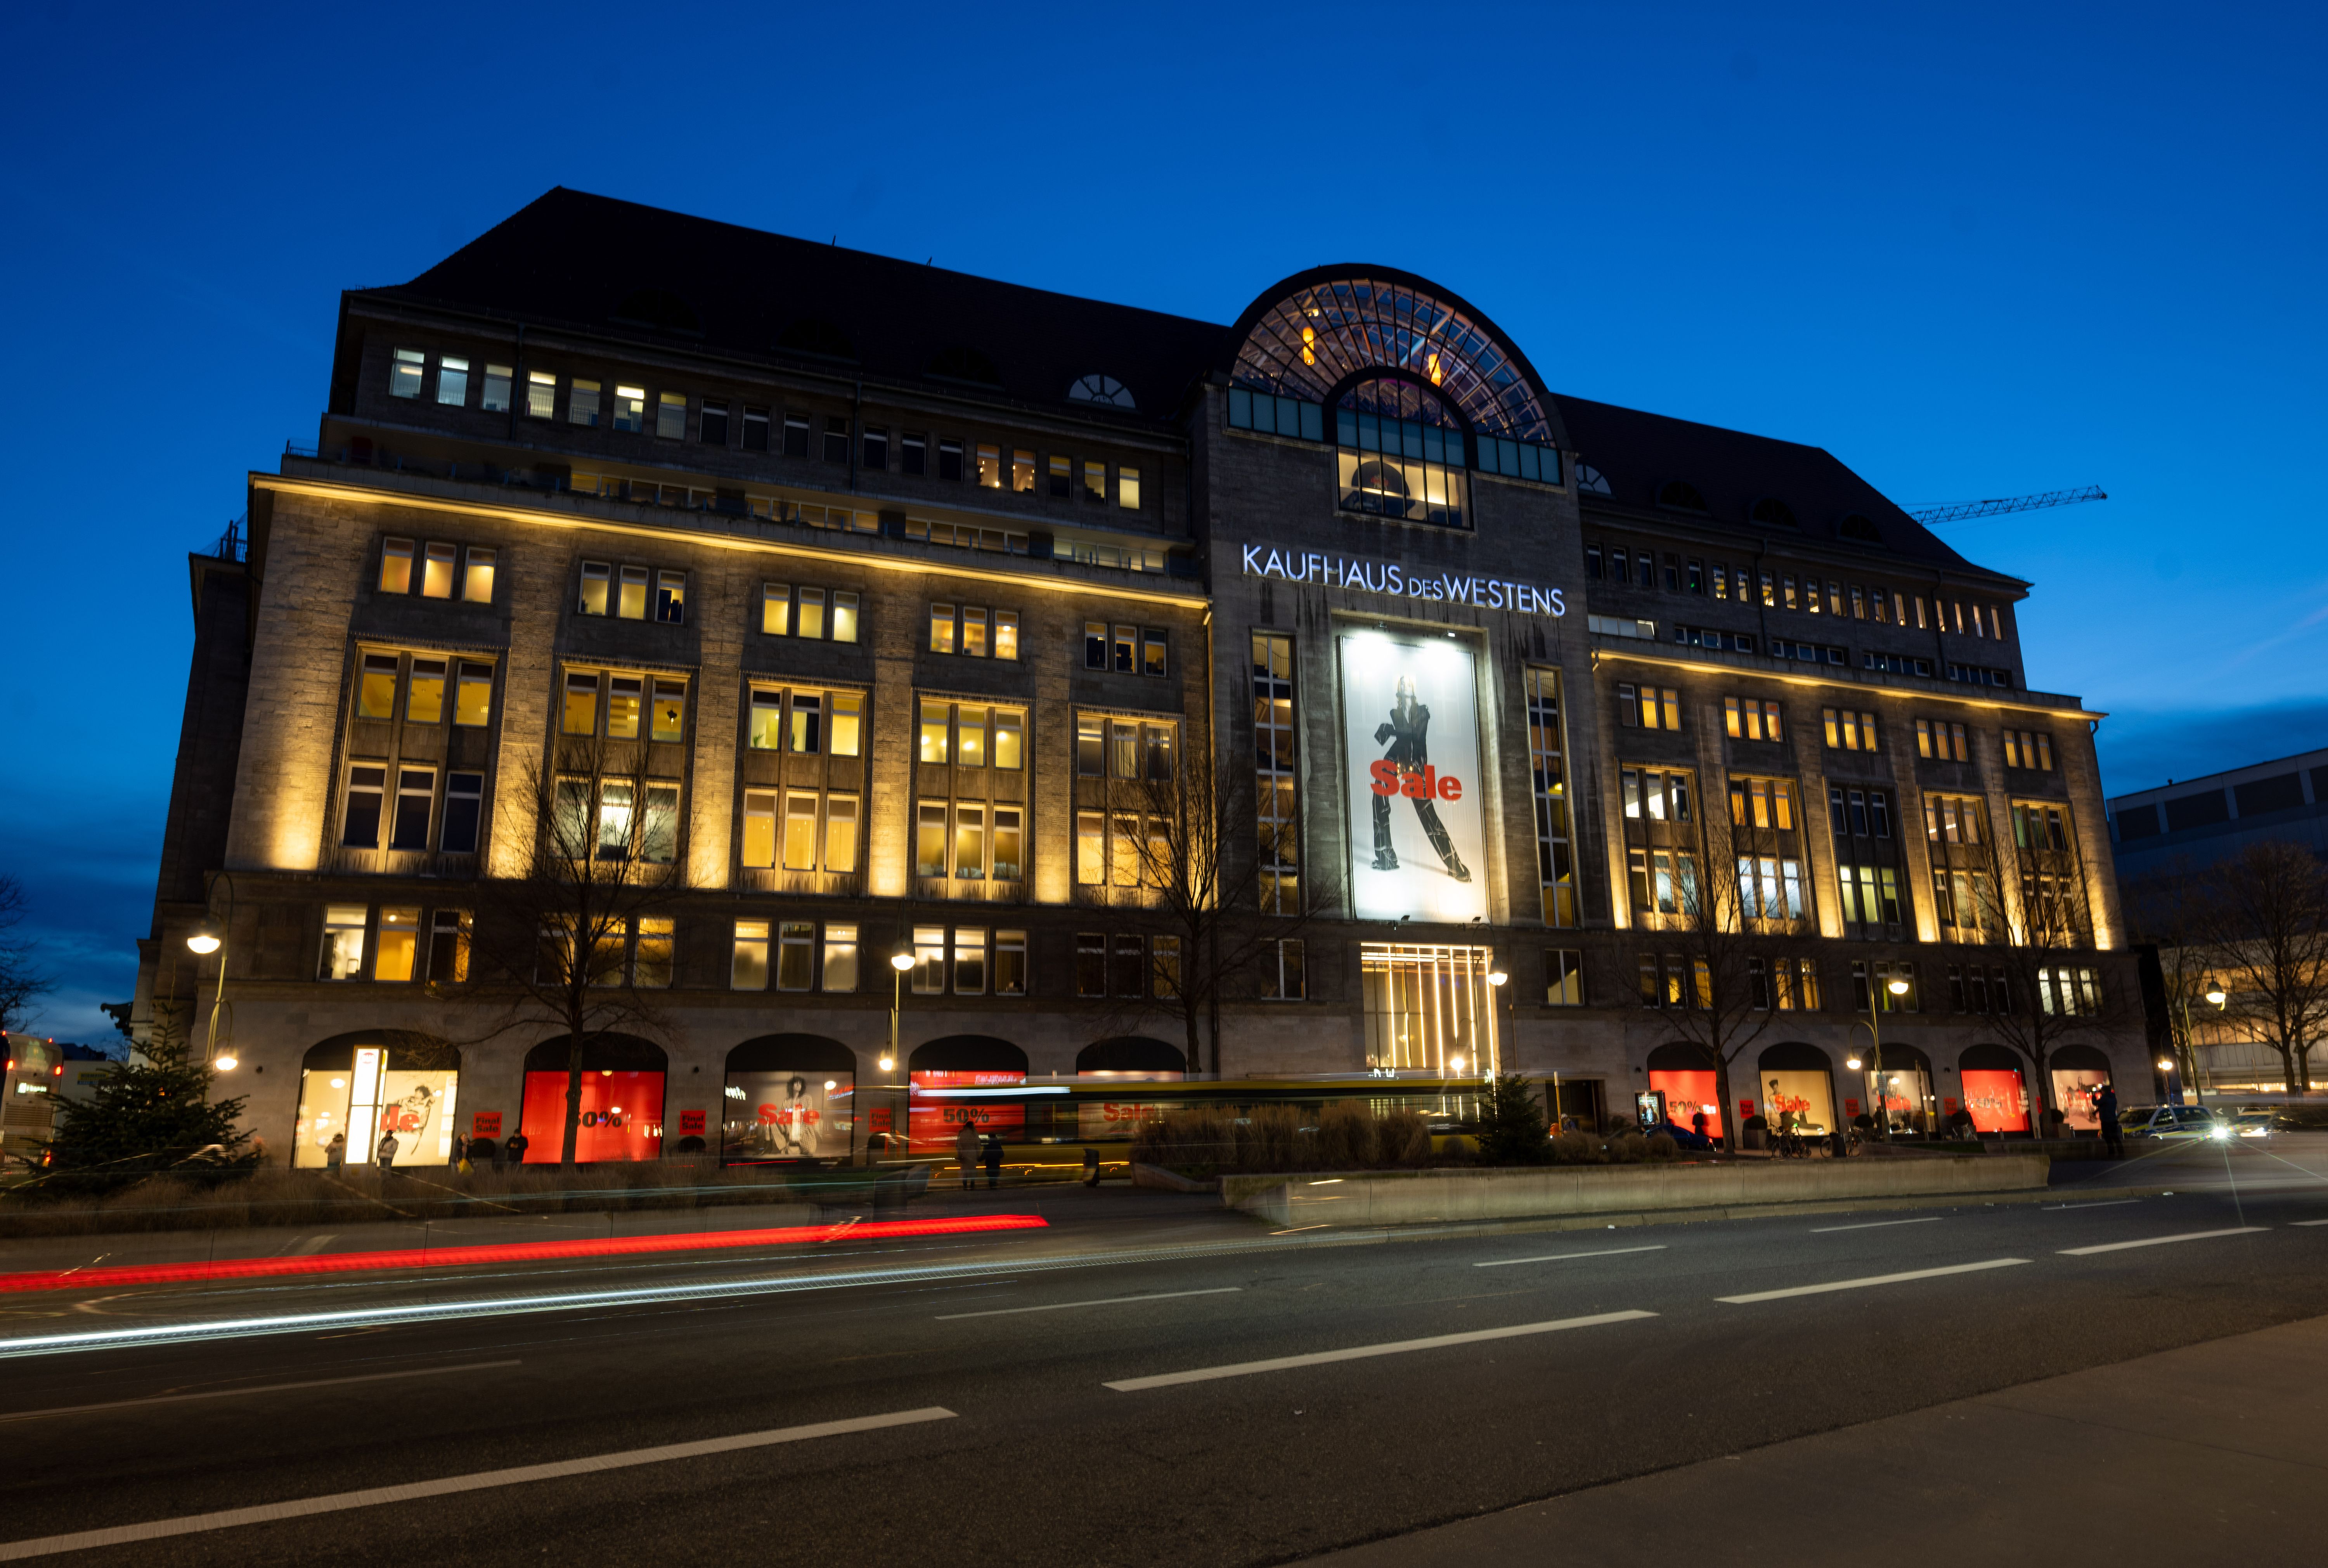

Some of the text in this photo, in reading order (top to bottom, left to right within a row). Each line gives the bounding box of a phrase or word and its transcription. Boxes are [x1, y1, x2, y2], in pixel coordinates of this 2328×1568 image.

[1243, 543, 1566, 617] KAUFHAUS DES WESTENS
[1370, 759, 1462, 802] Sale
[1775, 1093, 1810, 1112] Sale
[476, 1116, 499, 1124] Final
[578, 1111, 622, 1128] 0%
[757, 1103, 820, 1124] Sale
[943, 1108, 989, 1124] 50%
[476, 1124, 498, 1133] Sale
